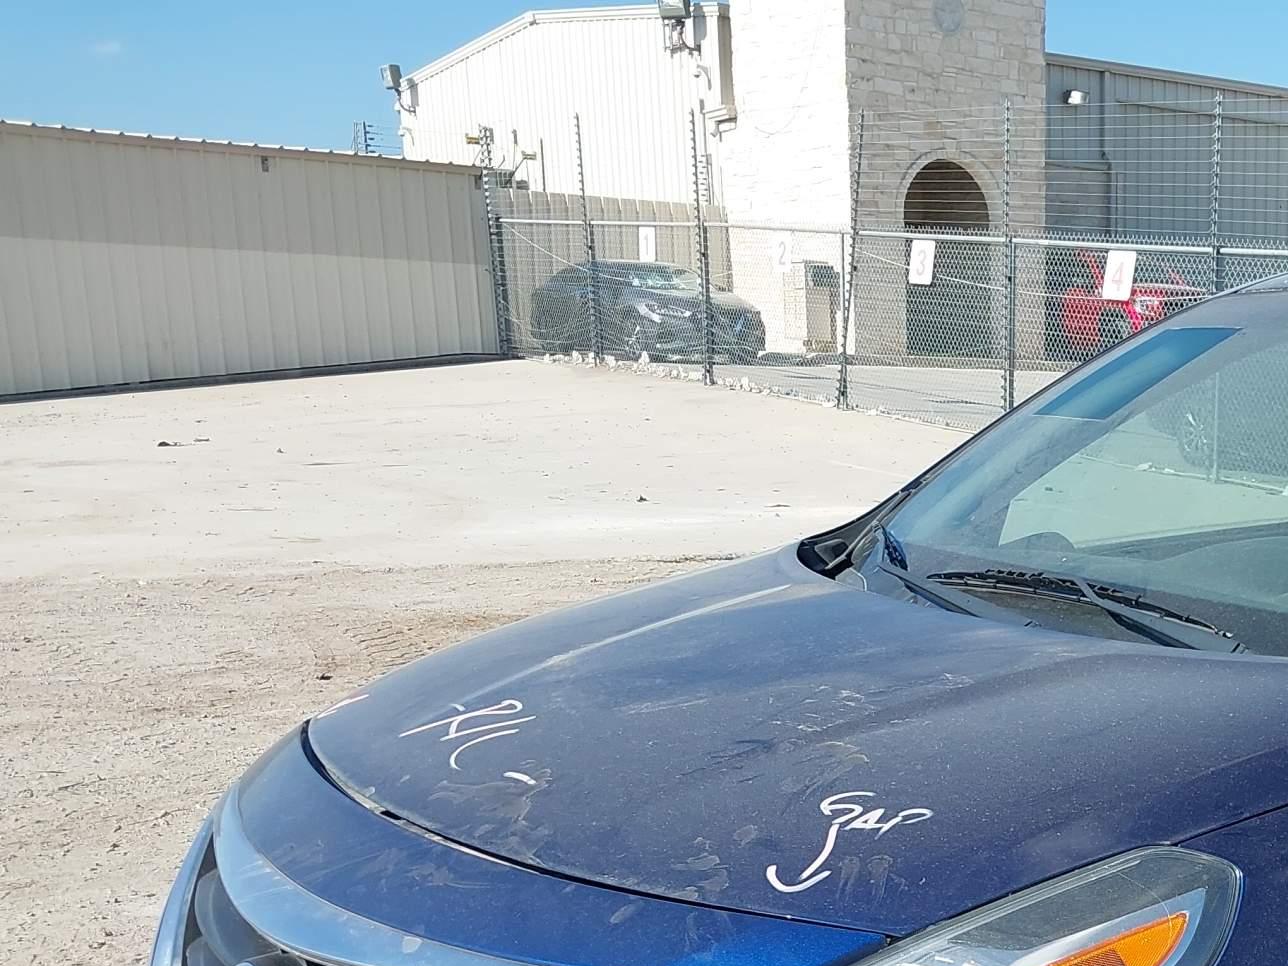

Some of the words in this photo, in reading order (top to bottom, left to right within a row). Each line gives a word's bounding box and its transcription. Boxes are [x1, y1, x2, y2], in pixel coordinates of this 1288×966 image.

[777, 240, 786, 266] 2
[916, 244, 927, 276] 3
[1111, 261, 1125, 292] 4
